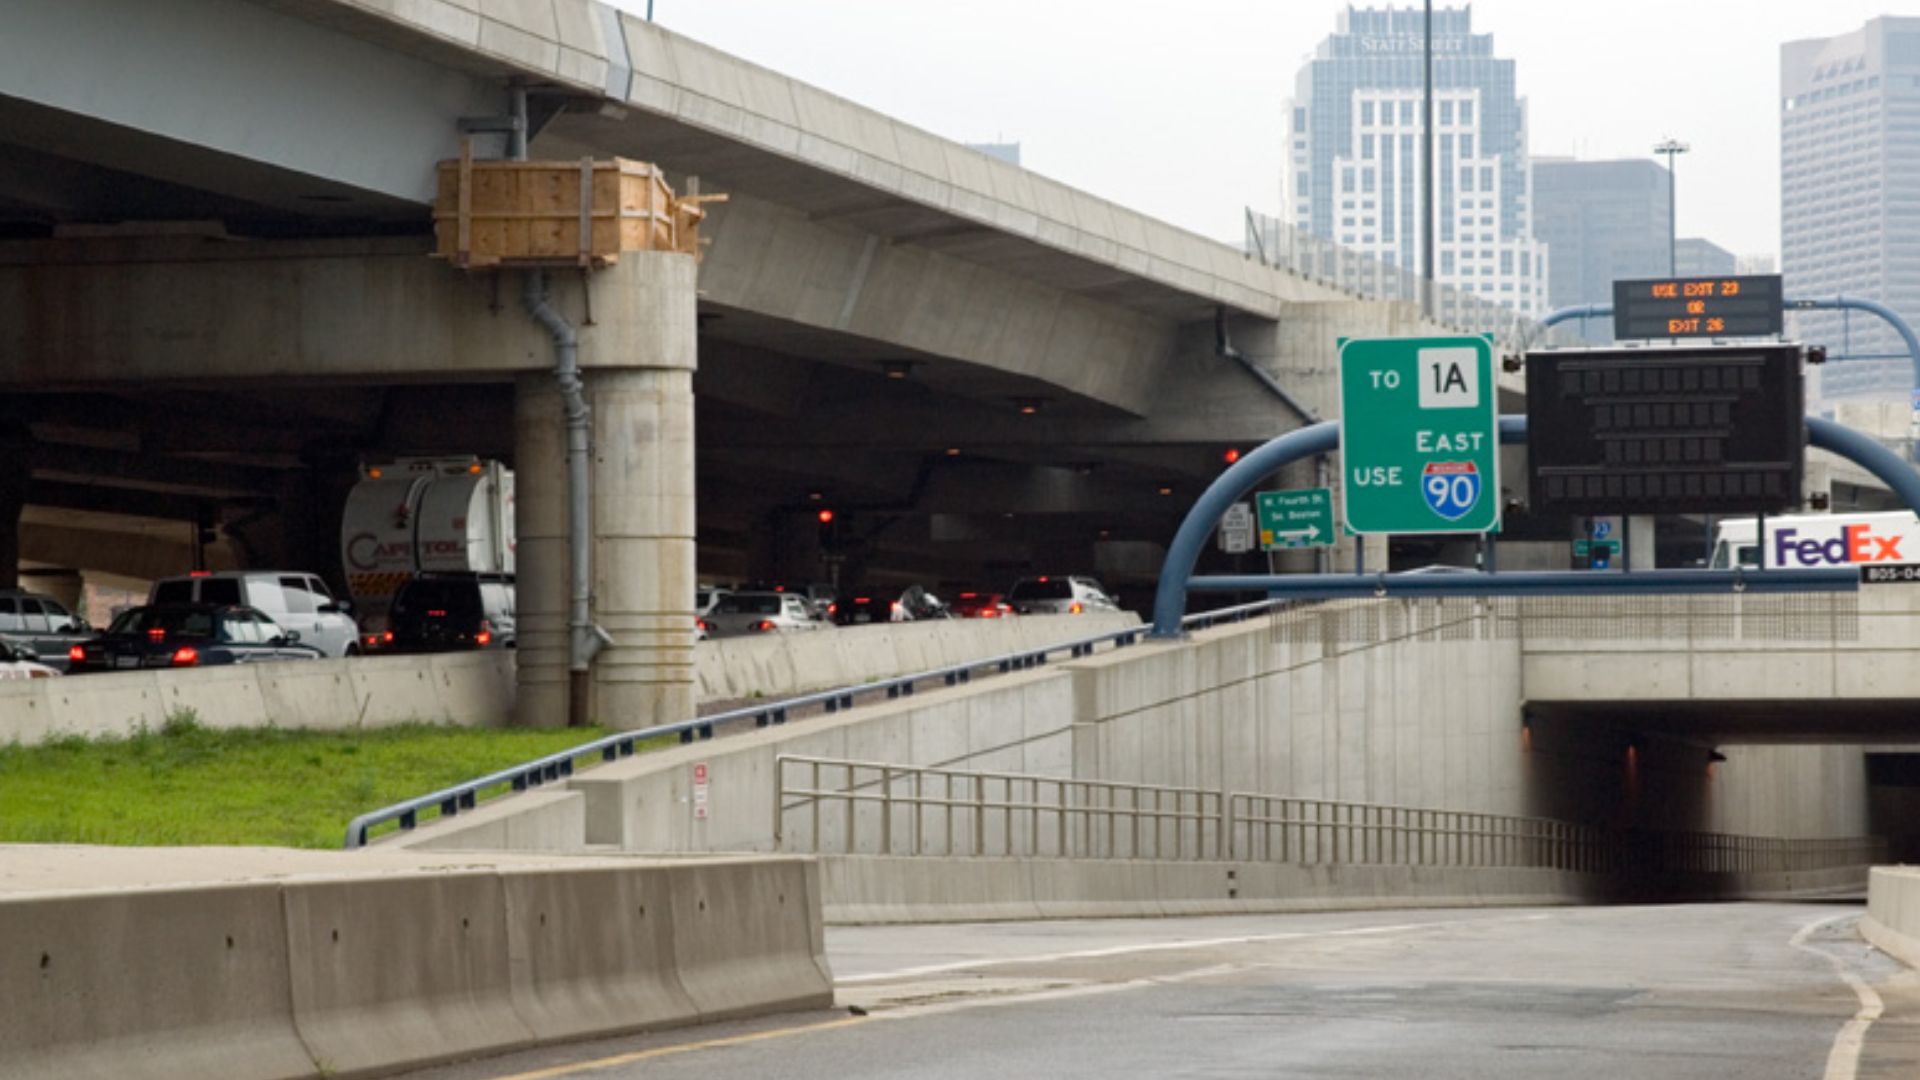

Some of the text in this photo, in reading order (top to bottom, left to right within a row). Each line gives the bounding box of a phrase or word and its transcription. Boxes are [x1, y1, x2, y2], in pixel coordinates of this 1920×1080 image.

[1408, 36, 1462, 51] STEET
[1652, 283, 1677, 298] USE
[1683, 282, 1715, 297] EXIT
[1687, 301, 1704, 314] OR
[1668, 318, 1699, 334] EXIT
[1369, 362, 1467, 394] TO 1A
[1416, 431, 1483, 452] EAST
[1354, 467, 1474, 508] USE 90
[1775, 524, 1903, 567] FedEx
